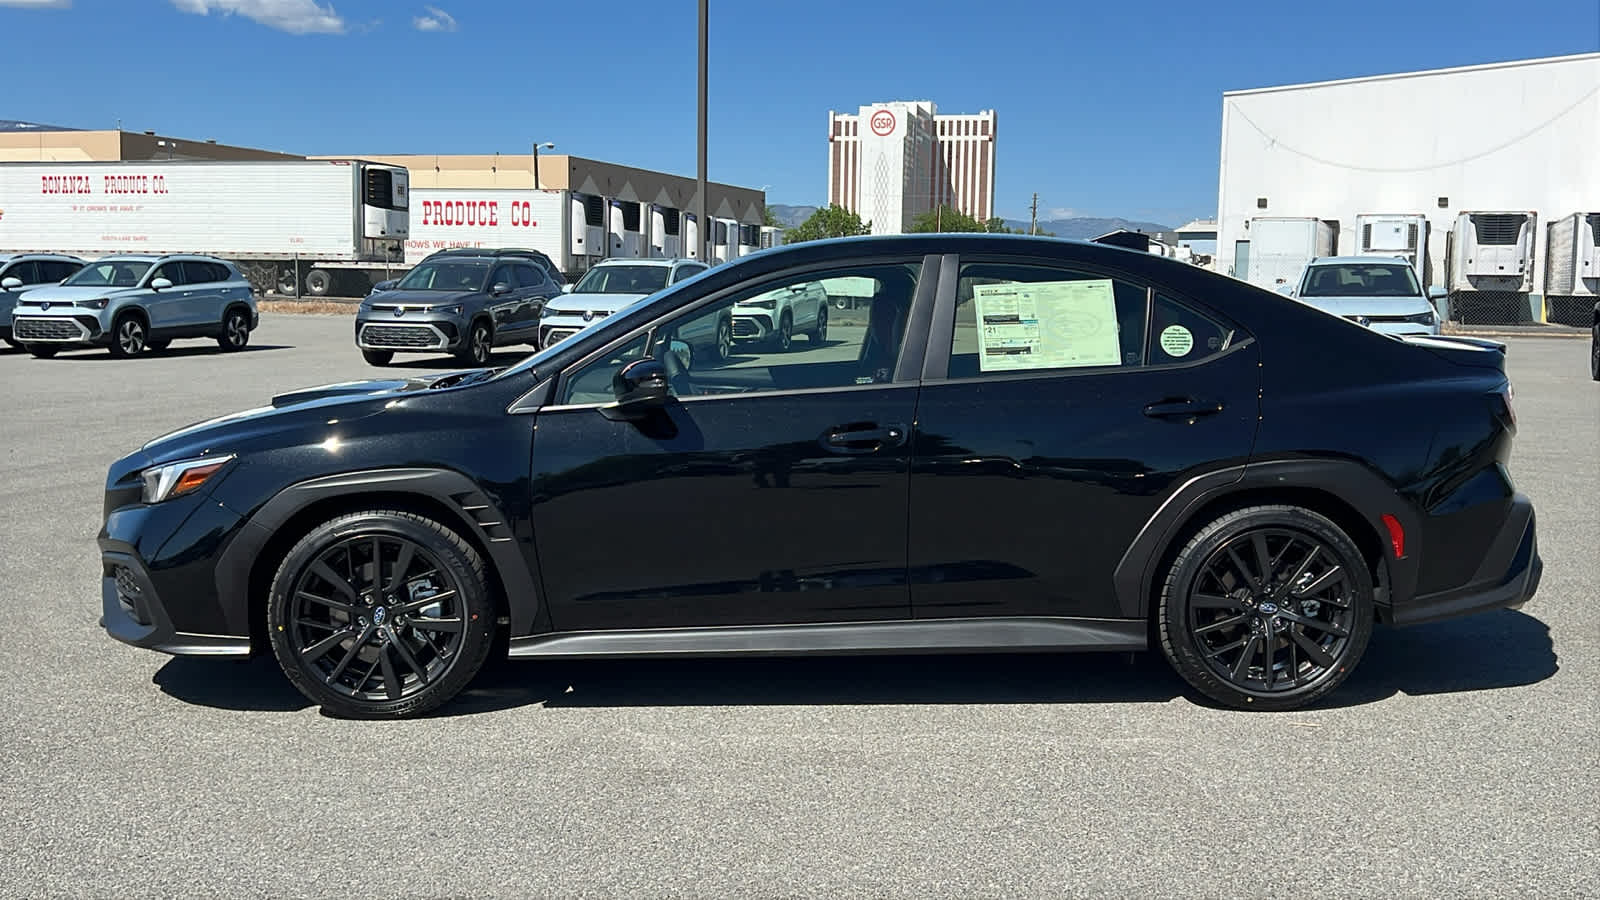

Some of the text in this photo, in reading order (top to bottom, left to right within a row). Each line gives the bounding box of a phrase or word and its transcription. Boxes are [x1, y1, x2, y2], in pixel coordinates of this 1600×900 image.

[874, 117, 892, 128] GSR
[42, 176, 168, 194] BONANZA PRODUCE CO.
[422, 200, 538, 226] PRODUCE CO.
